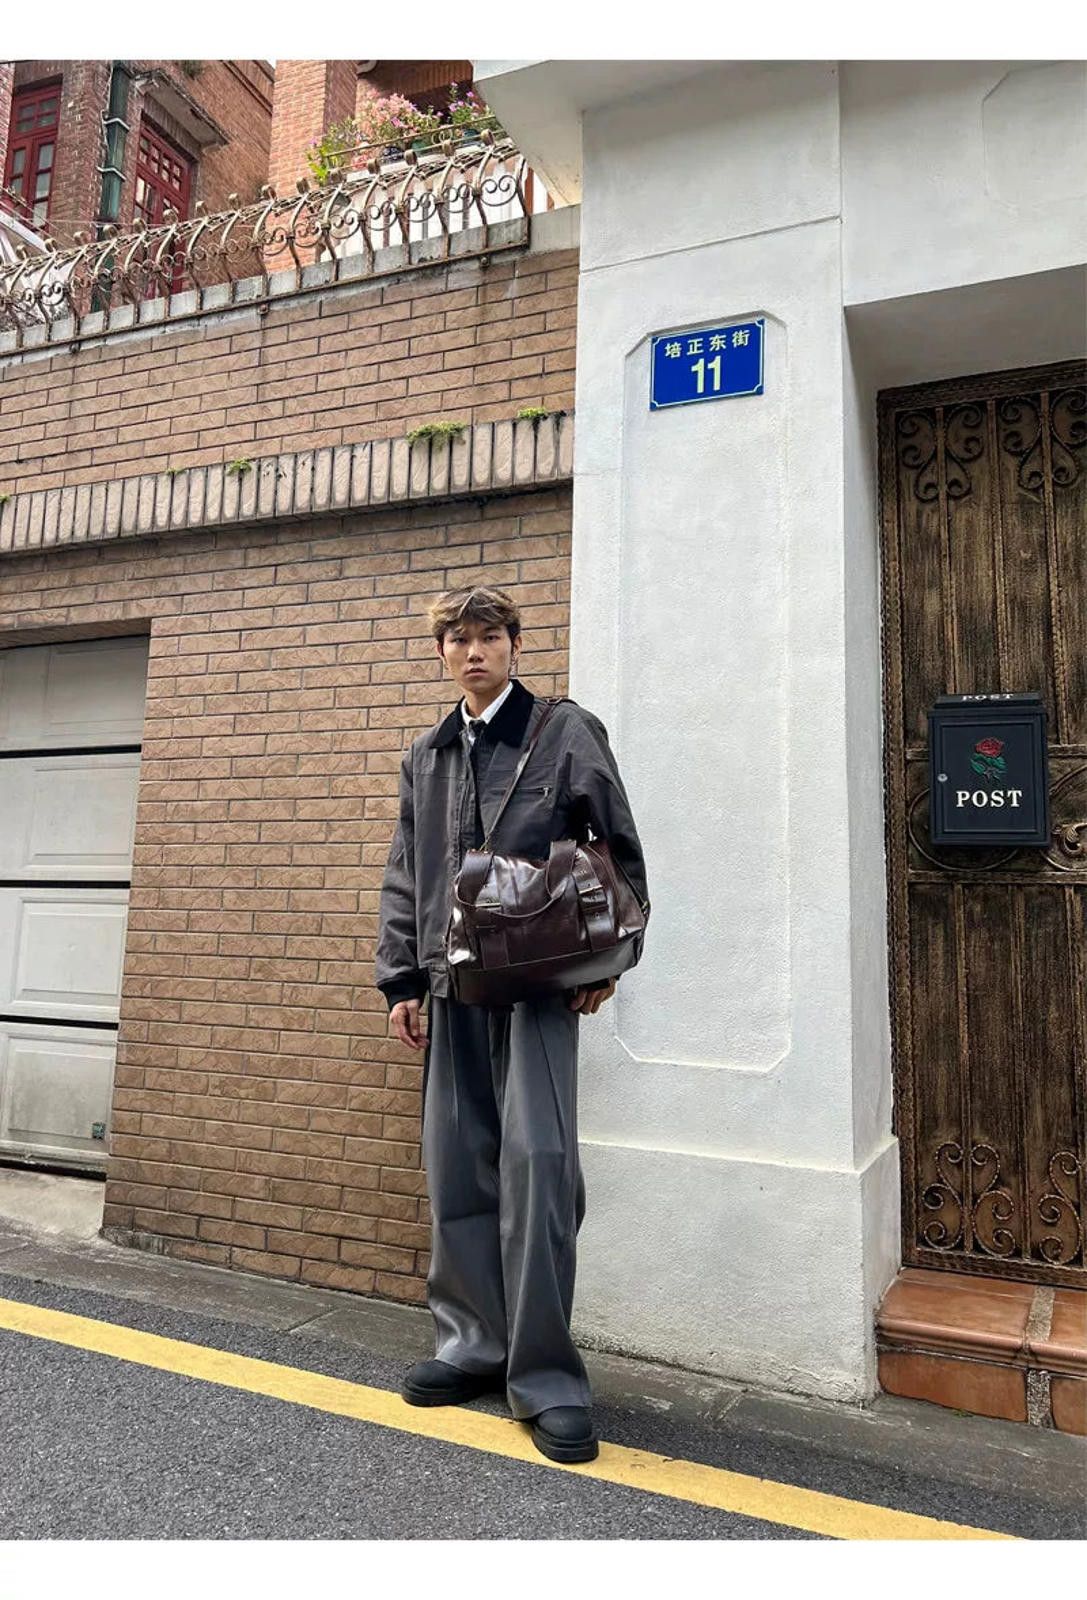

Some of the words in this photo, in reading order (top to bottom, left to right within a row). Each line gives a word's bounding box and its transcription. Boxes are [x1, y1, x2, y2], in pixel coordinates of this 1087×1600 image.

[664, 329, 750, 358] 培正东街
[691, 355, 721, 393] 11
[962, 693, 1014, 701] POST
[956, 790, 1023, 807] POST
